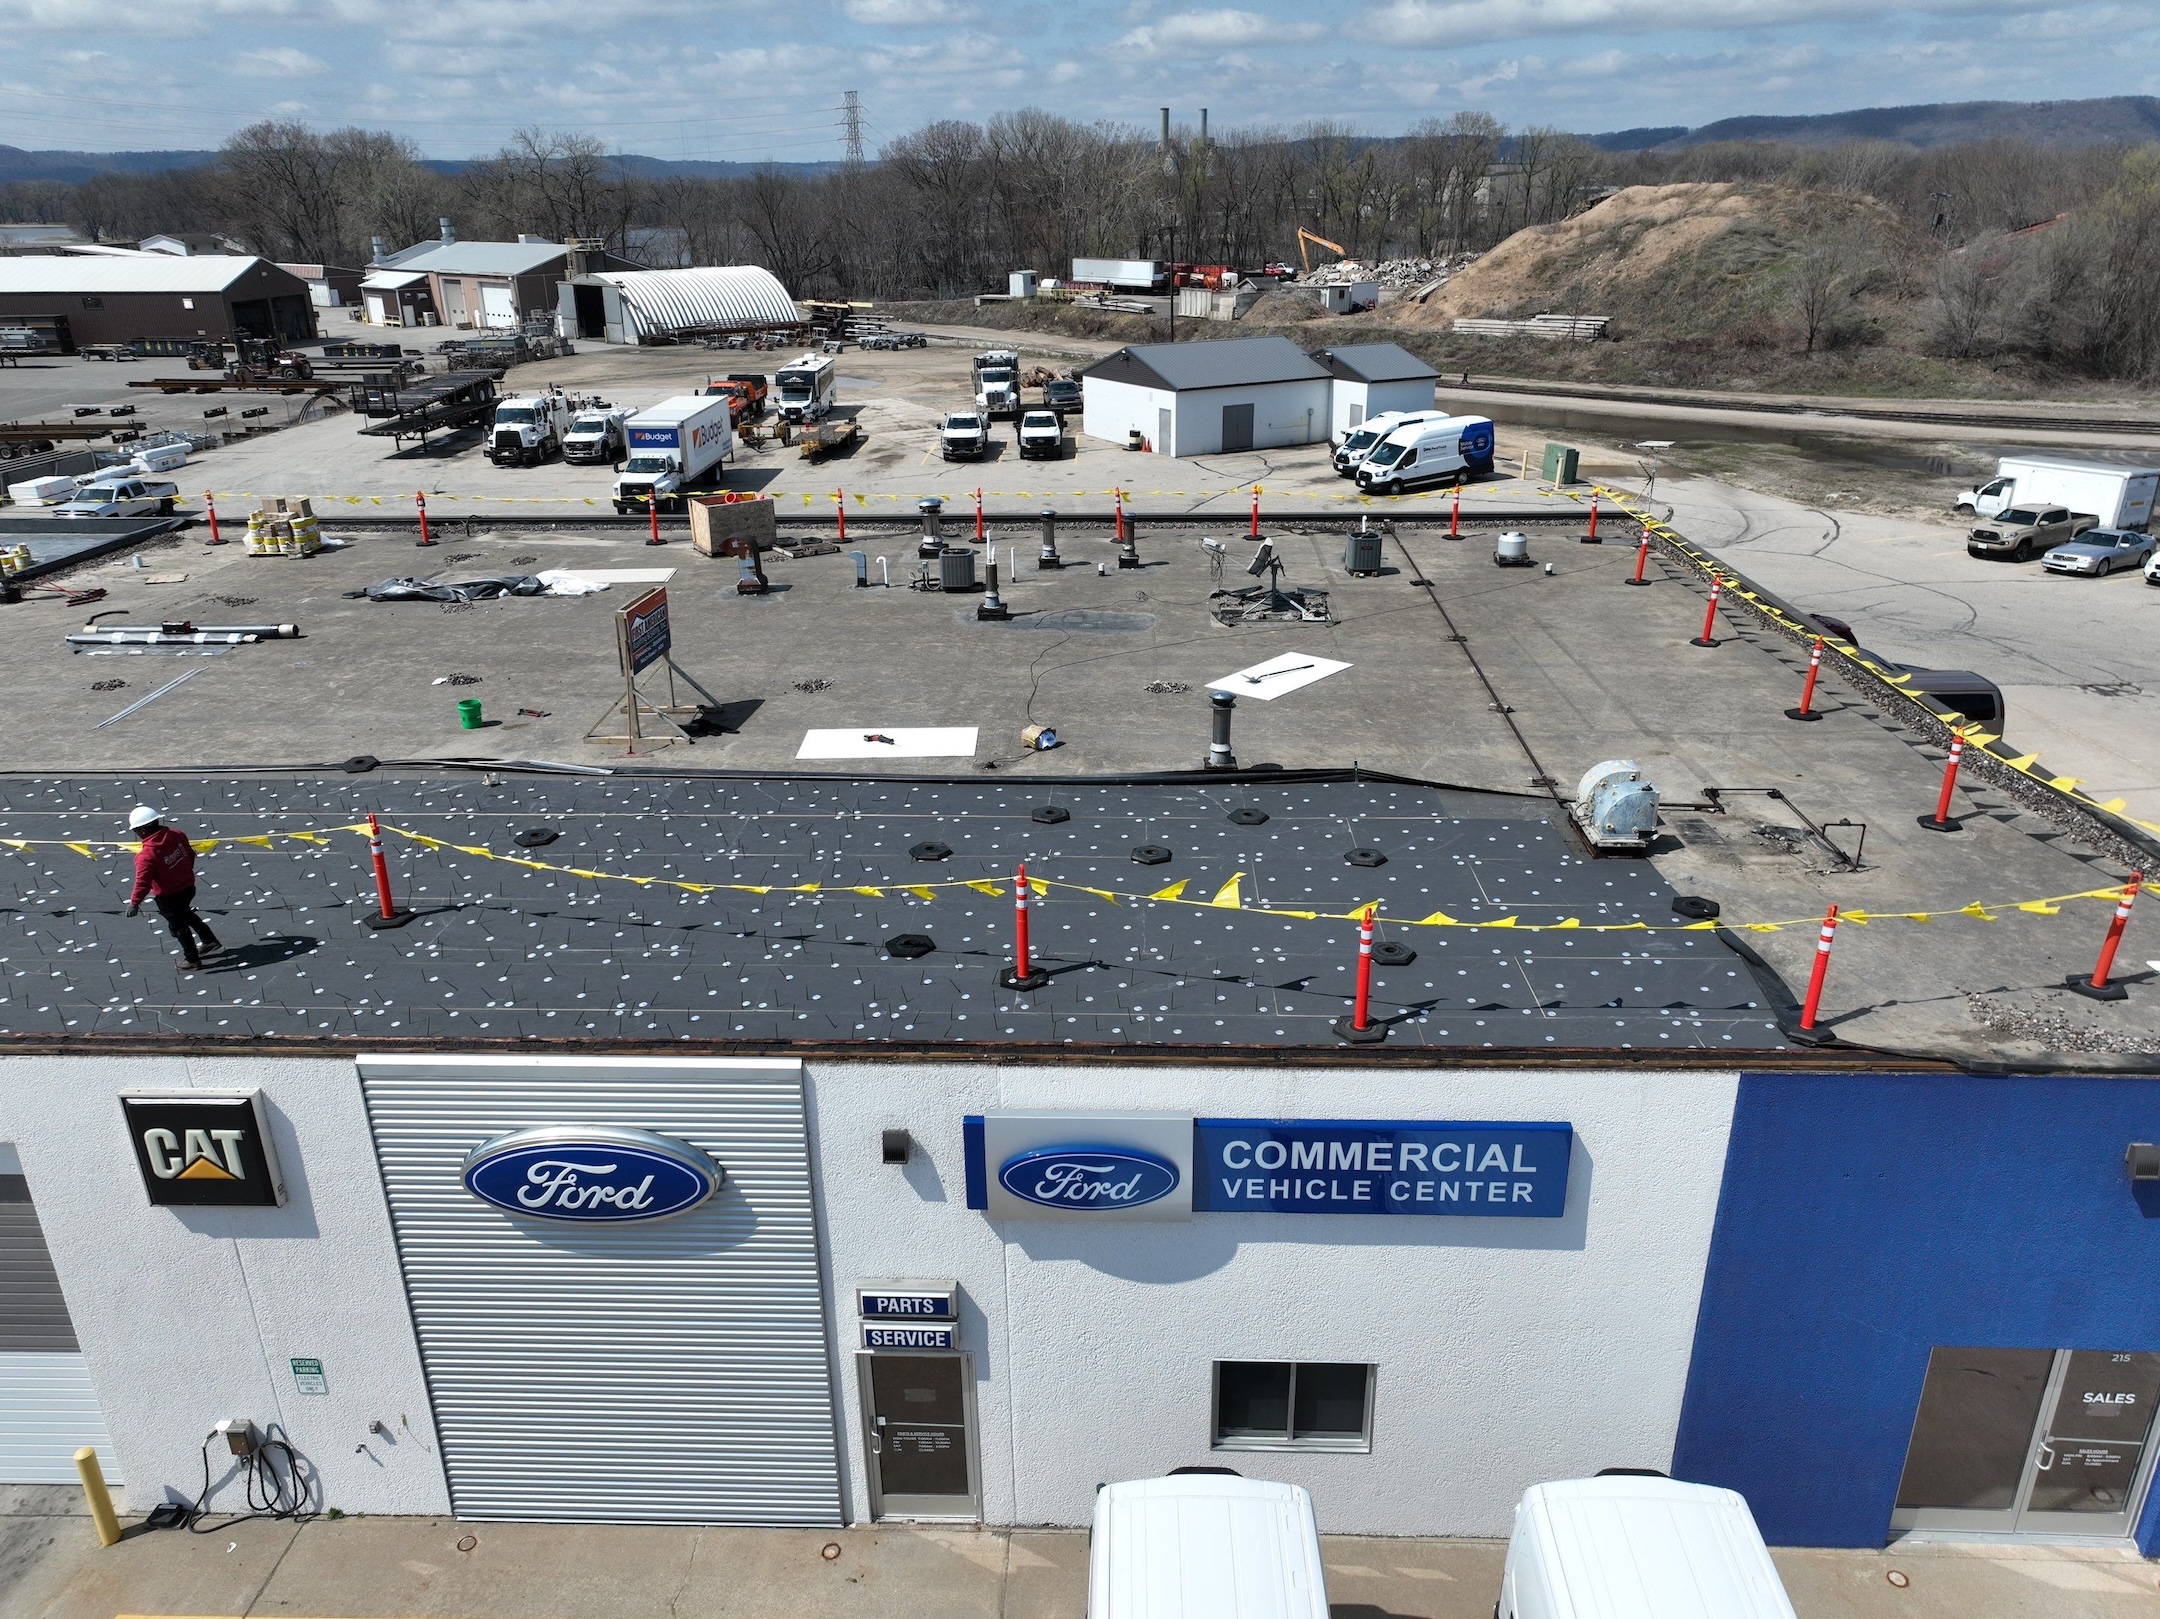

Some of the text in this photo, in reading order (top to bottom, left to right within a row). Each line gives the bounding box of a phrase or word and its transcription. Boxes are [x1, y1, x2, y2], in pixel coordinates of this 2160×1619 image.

[645, 432, 673, 443] Budget
[701, 416, 724, 445] Budget
[631, 606, 666, 641] FIRST AMERICAN
[144, 1128, 246, 1180] CAT
[1222, 1140, 1537, 1173] COMMERCIAL
[517, 1160, 655, 1209] Ford
[1035, 1163, 1142, 1200] Ford
[1222, 1178, 1534, 1203] VEHICLE CENTER
[877, 1297, 935, 1314] PARTS
[871, 1330, 946, 1347] SERVICE
[2111, 1354, 2131, 1362] 215
[2082, 1392, 2136, 1404] SALES
